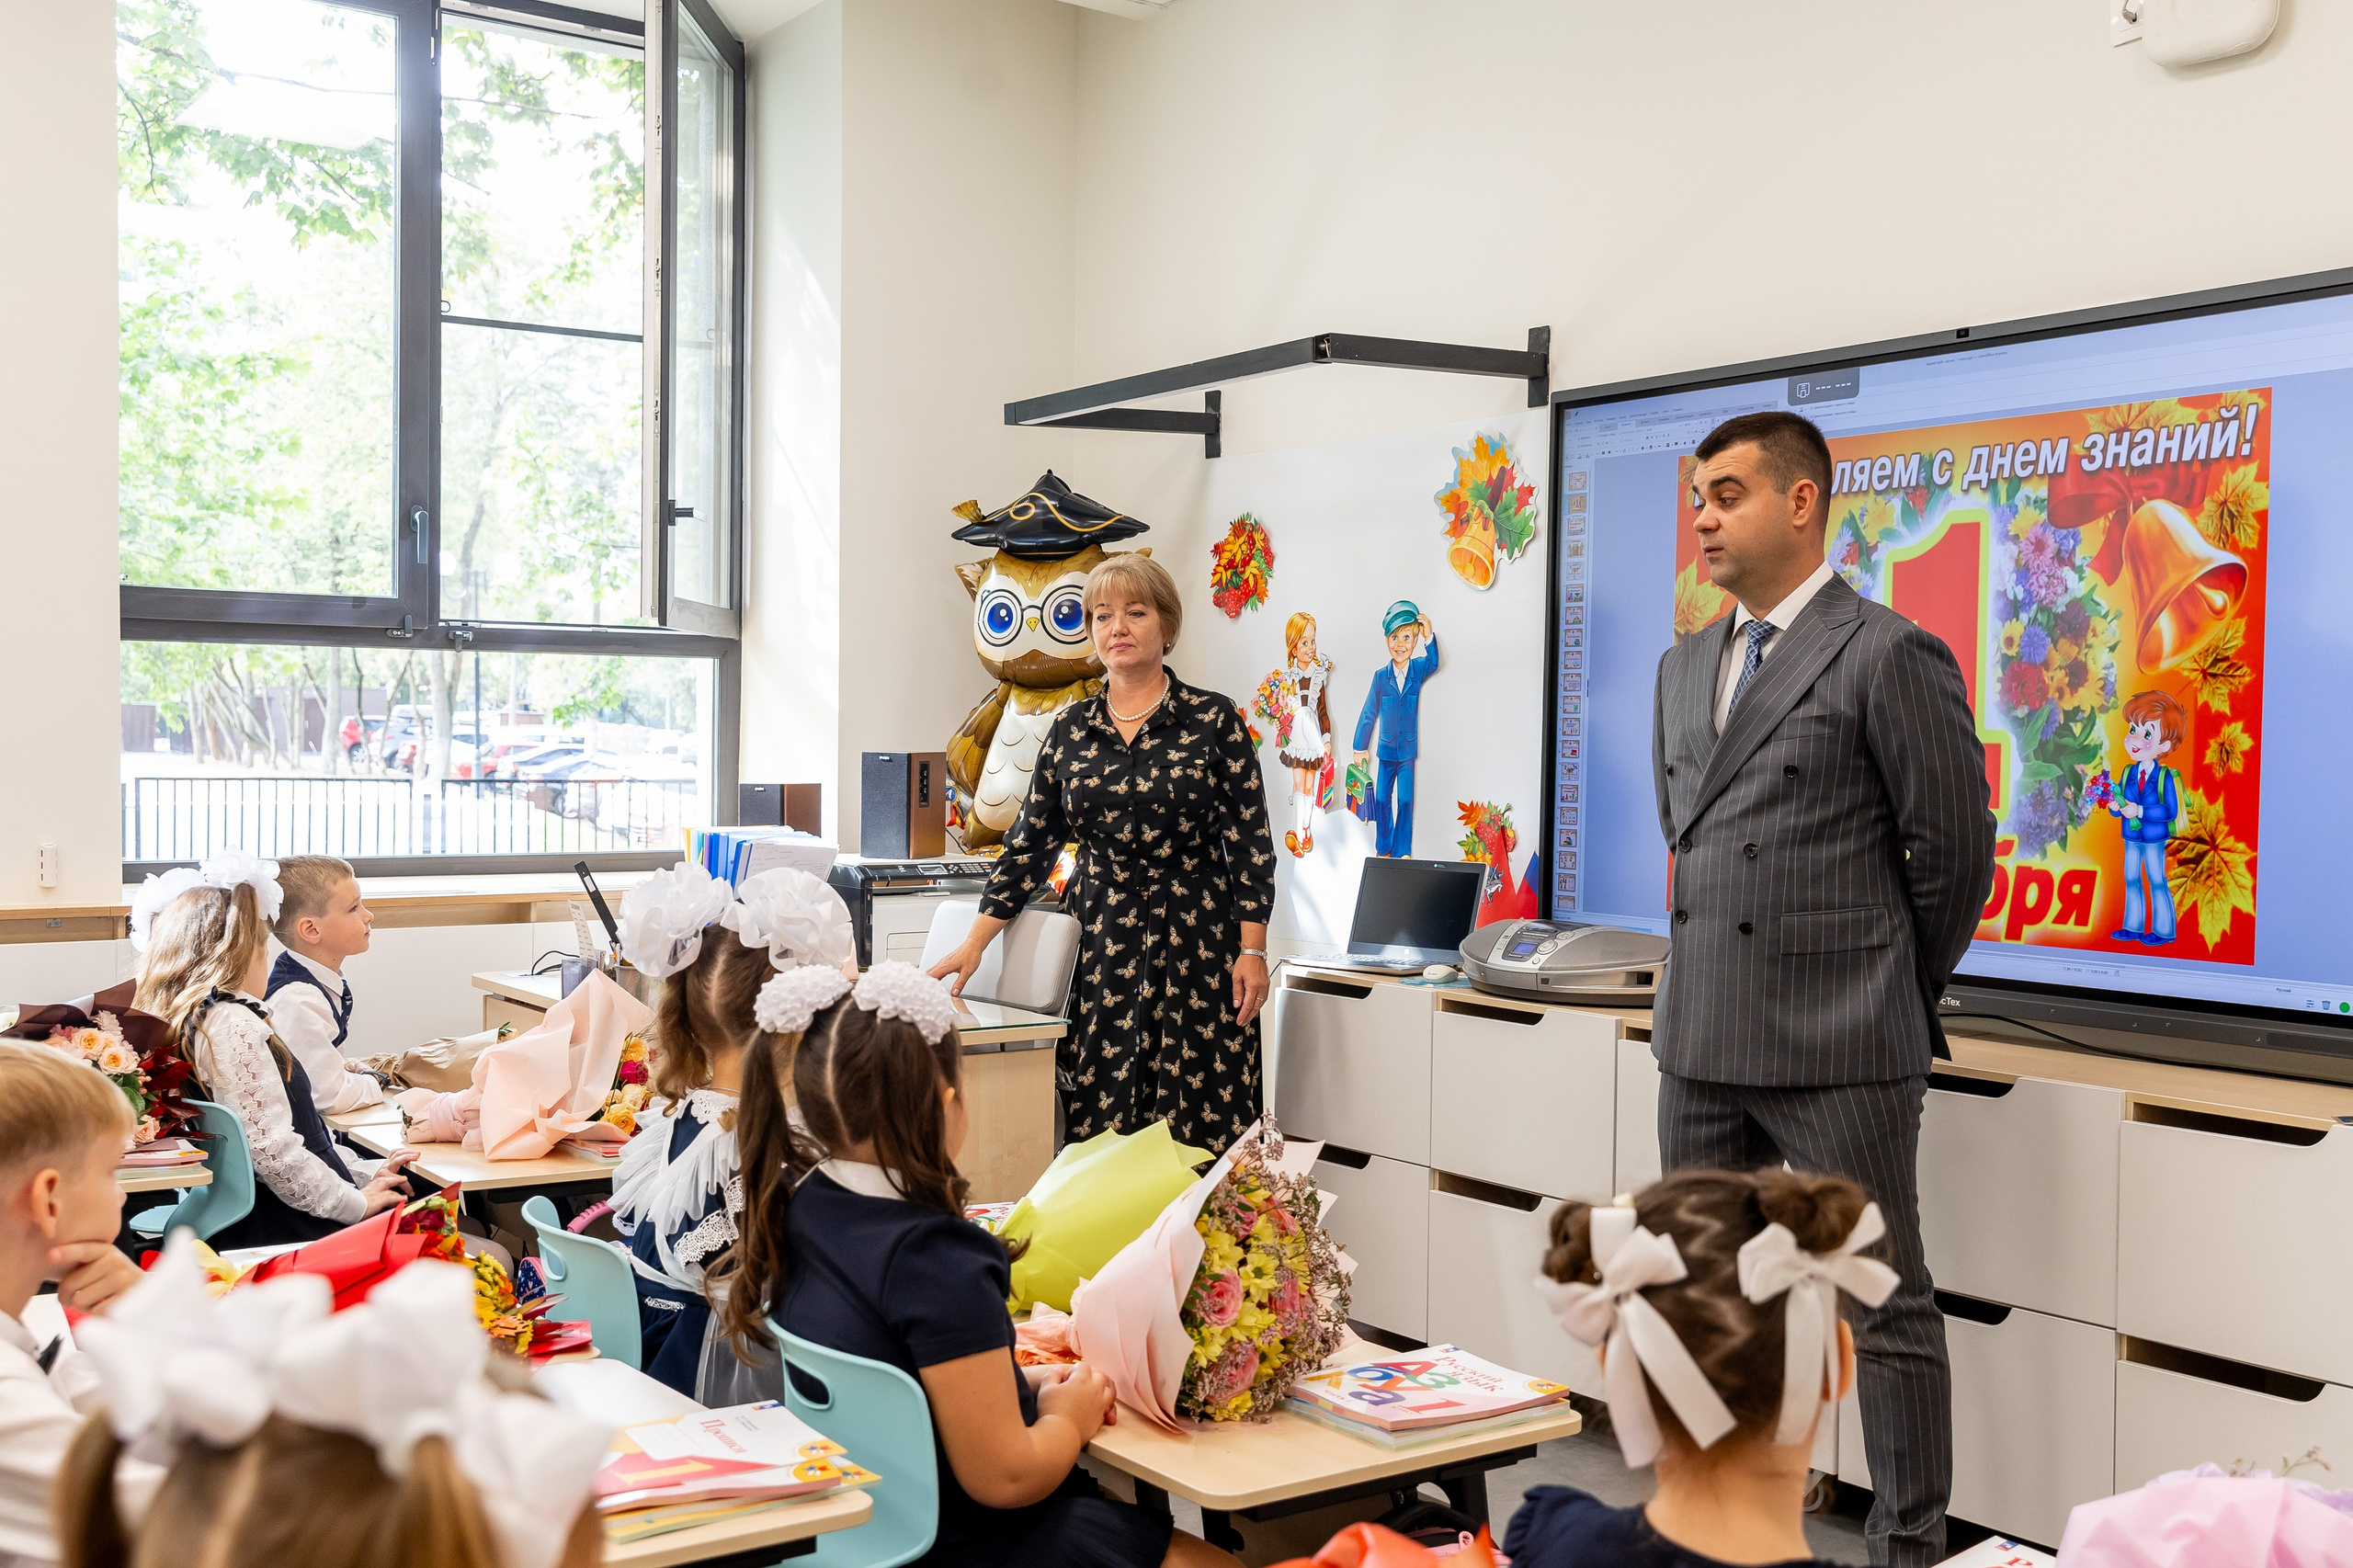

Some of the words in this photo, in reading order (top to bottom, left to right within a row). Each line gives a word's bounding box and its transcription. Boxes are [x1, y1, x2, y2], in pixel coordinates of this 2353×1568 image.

[1831, 452, 1921, 494] ляем
[1931, 449, 1955, 485] с
[1961, 437, 2070, 491] днем
[2080, 403, 2259, 473] знаний!
[1434, 1356, 1503, 1383] Русский
[699, 1418, 748, 1454] Прописи
